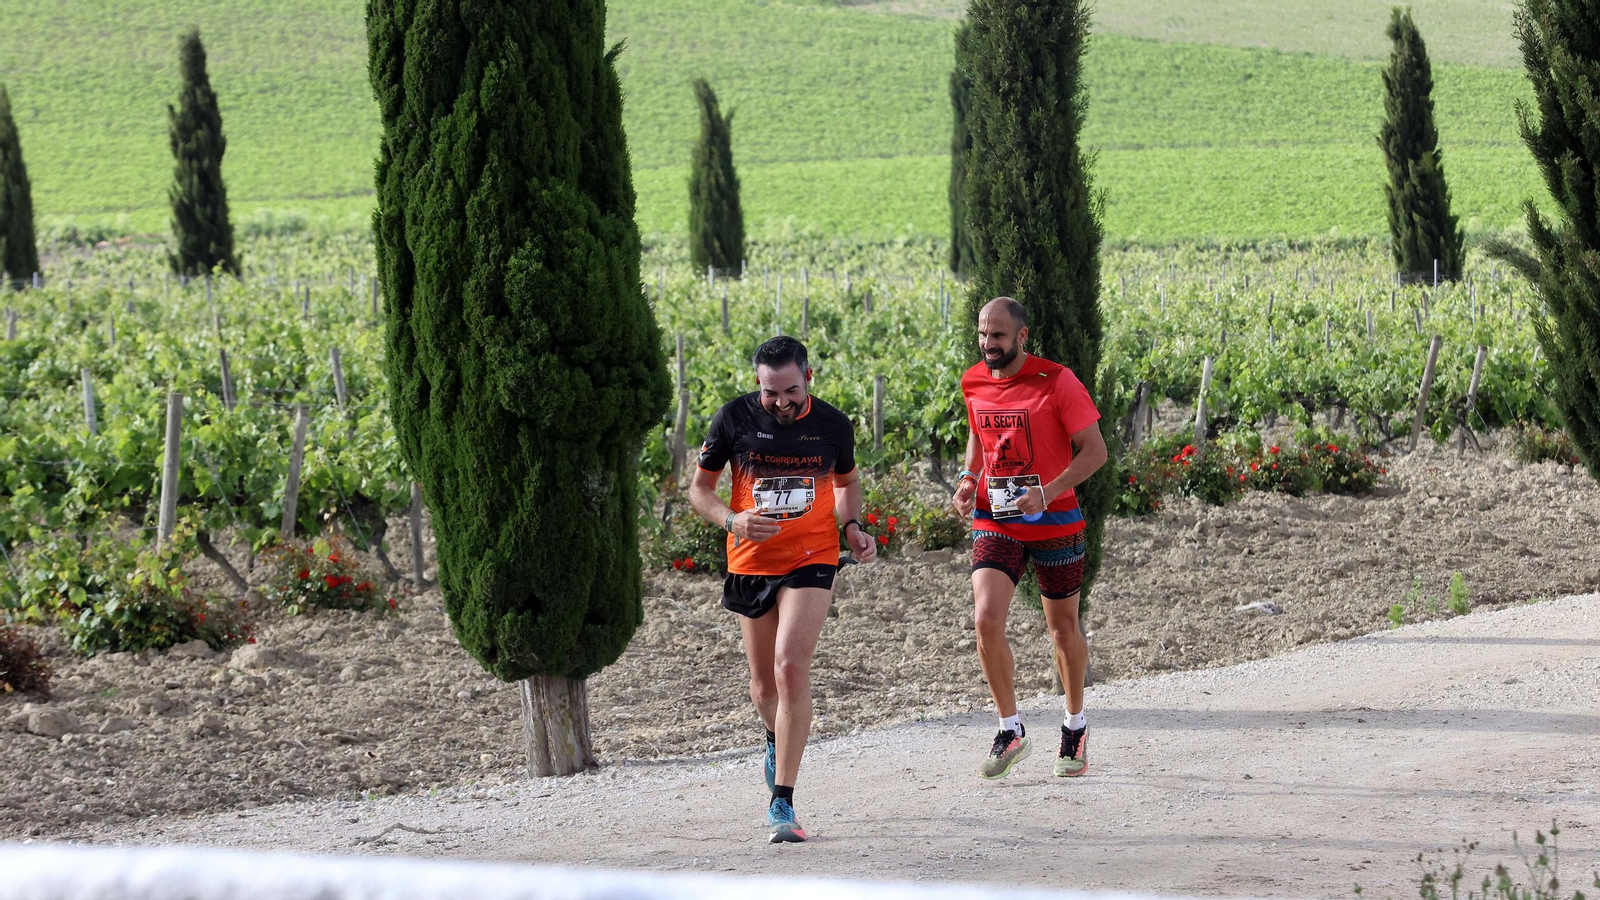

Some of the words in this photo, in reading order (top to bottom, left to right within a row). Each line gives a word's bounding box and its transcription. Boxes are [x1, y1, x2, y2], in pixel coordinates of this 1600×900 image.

[980, 415, 992, 428] LA
[994, 415, 1024, 428] SECTA
[764, 455, 822, 464] CORREPLAYAS
[774, 490, 792, 505] 77
